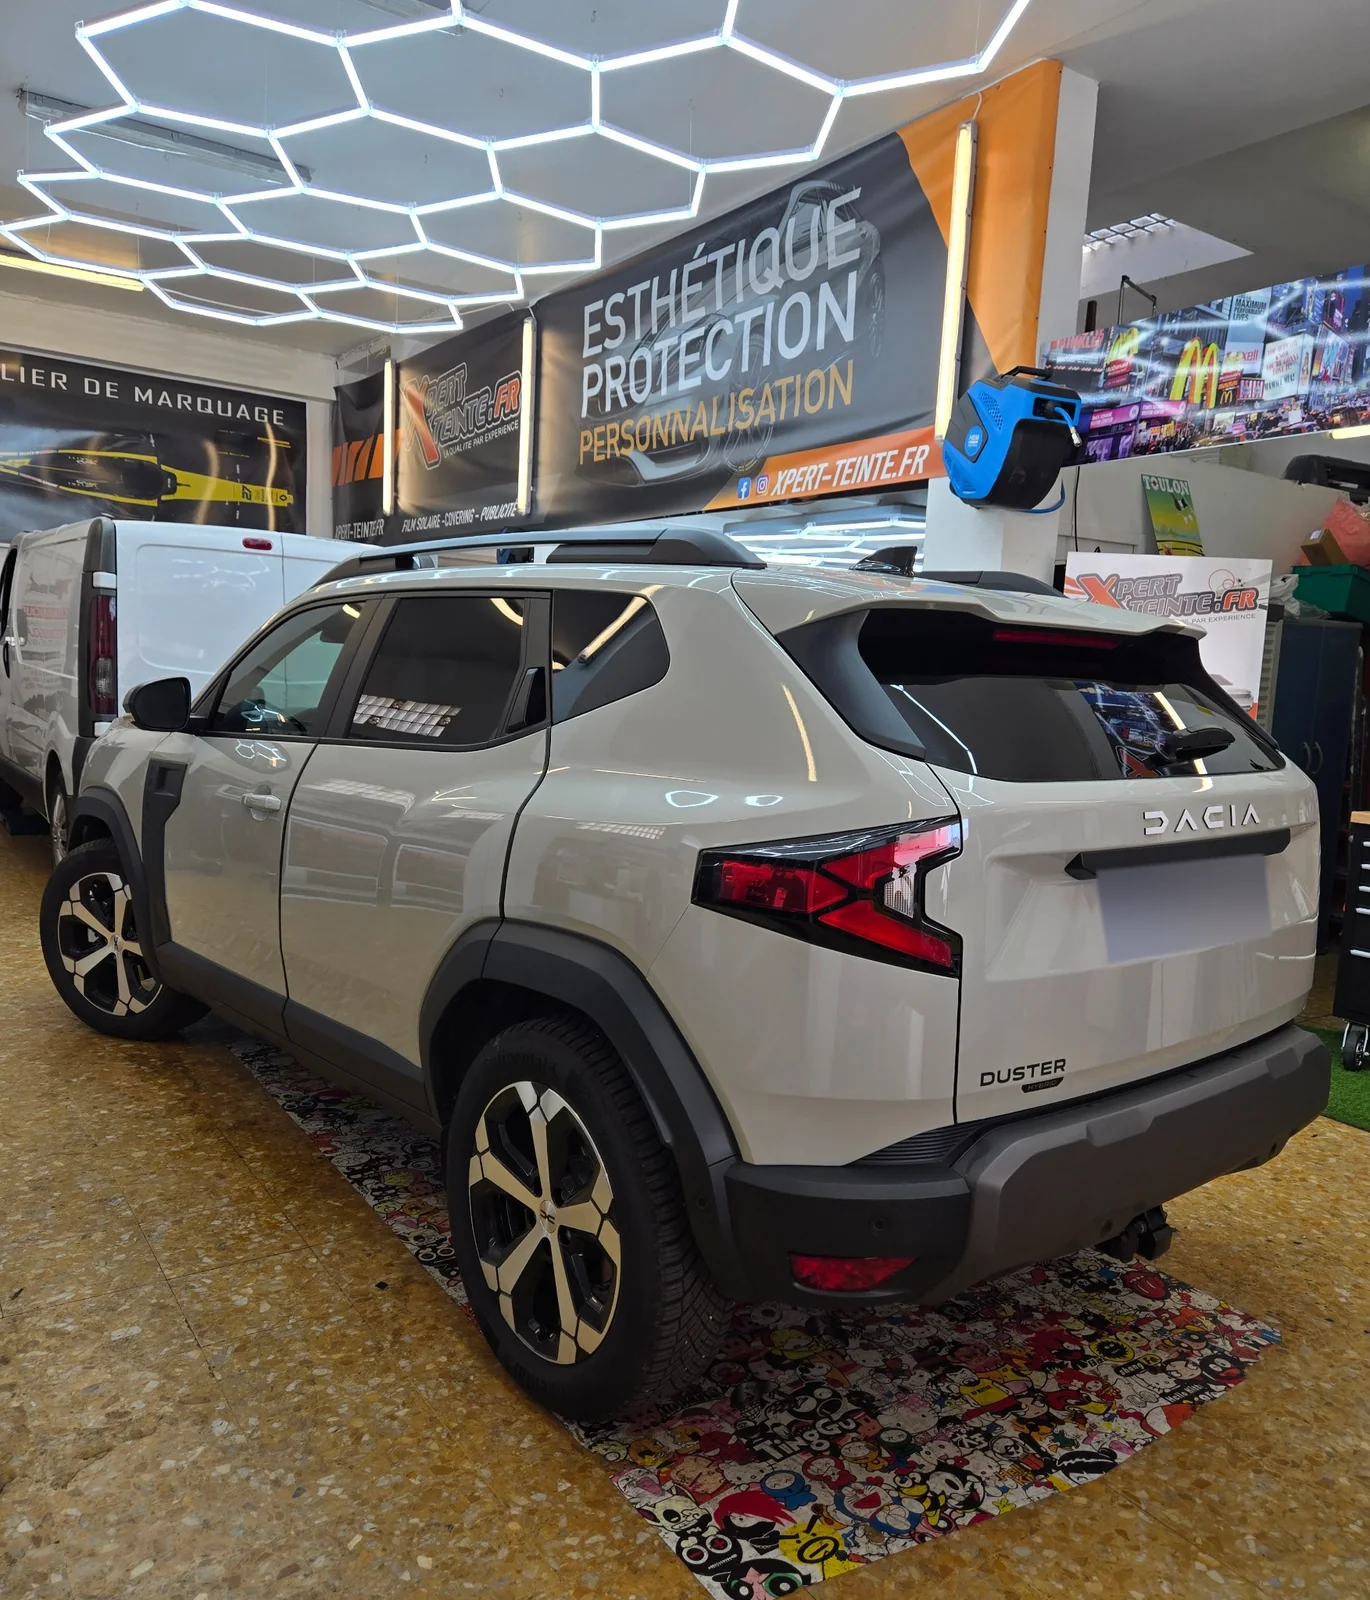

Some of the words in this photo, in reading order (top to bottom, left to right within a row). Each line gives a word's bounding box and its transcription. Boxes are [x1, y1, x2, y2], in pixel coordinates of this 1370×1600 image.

[583, 187, 862, 359] ESTHÉTIQUE
[1235, 298, 1267, 309] MAXIMUM
[581, 271, 858, 418] PROTECTION
[1, 363, 67, 391] LIER
[84, 378, 119, 400] DE
[134, 386, 286, 426] MARQUAGE
[579, 360, 854, 465] PERSONNALISATION
[473, 436, 484, 449] PAR
[484, 419, 519, 442] EXPERIENCE
[771, 443, 930, 497] XPERT-TEINTE.FR
[1143, 474, 1190, 495] TOULON
[402, 517, 416, 533] FILM
[417, 514, 441, 530] SOLAIRE
[1208, 613, 1256, 623] EXPERIENCE
[1143, 802, 1261, 836] DACIA
[980, 1058, 1067, 1087] DUSTER
[1027, 1079, 1058, 1091] HYBRID
